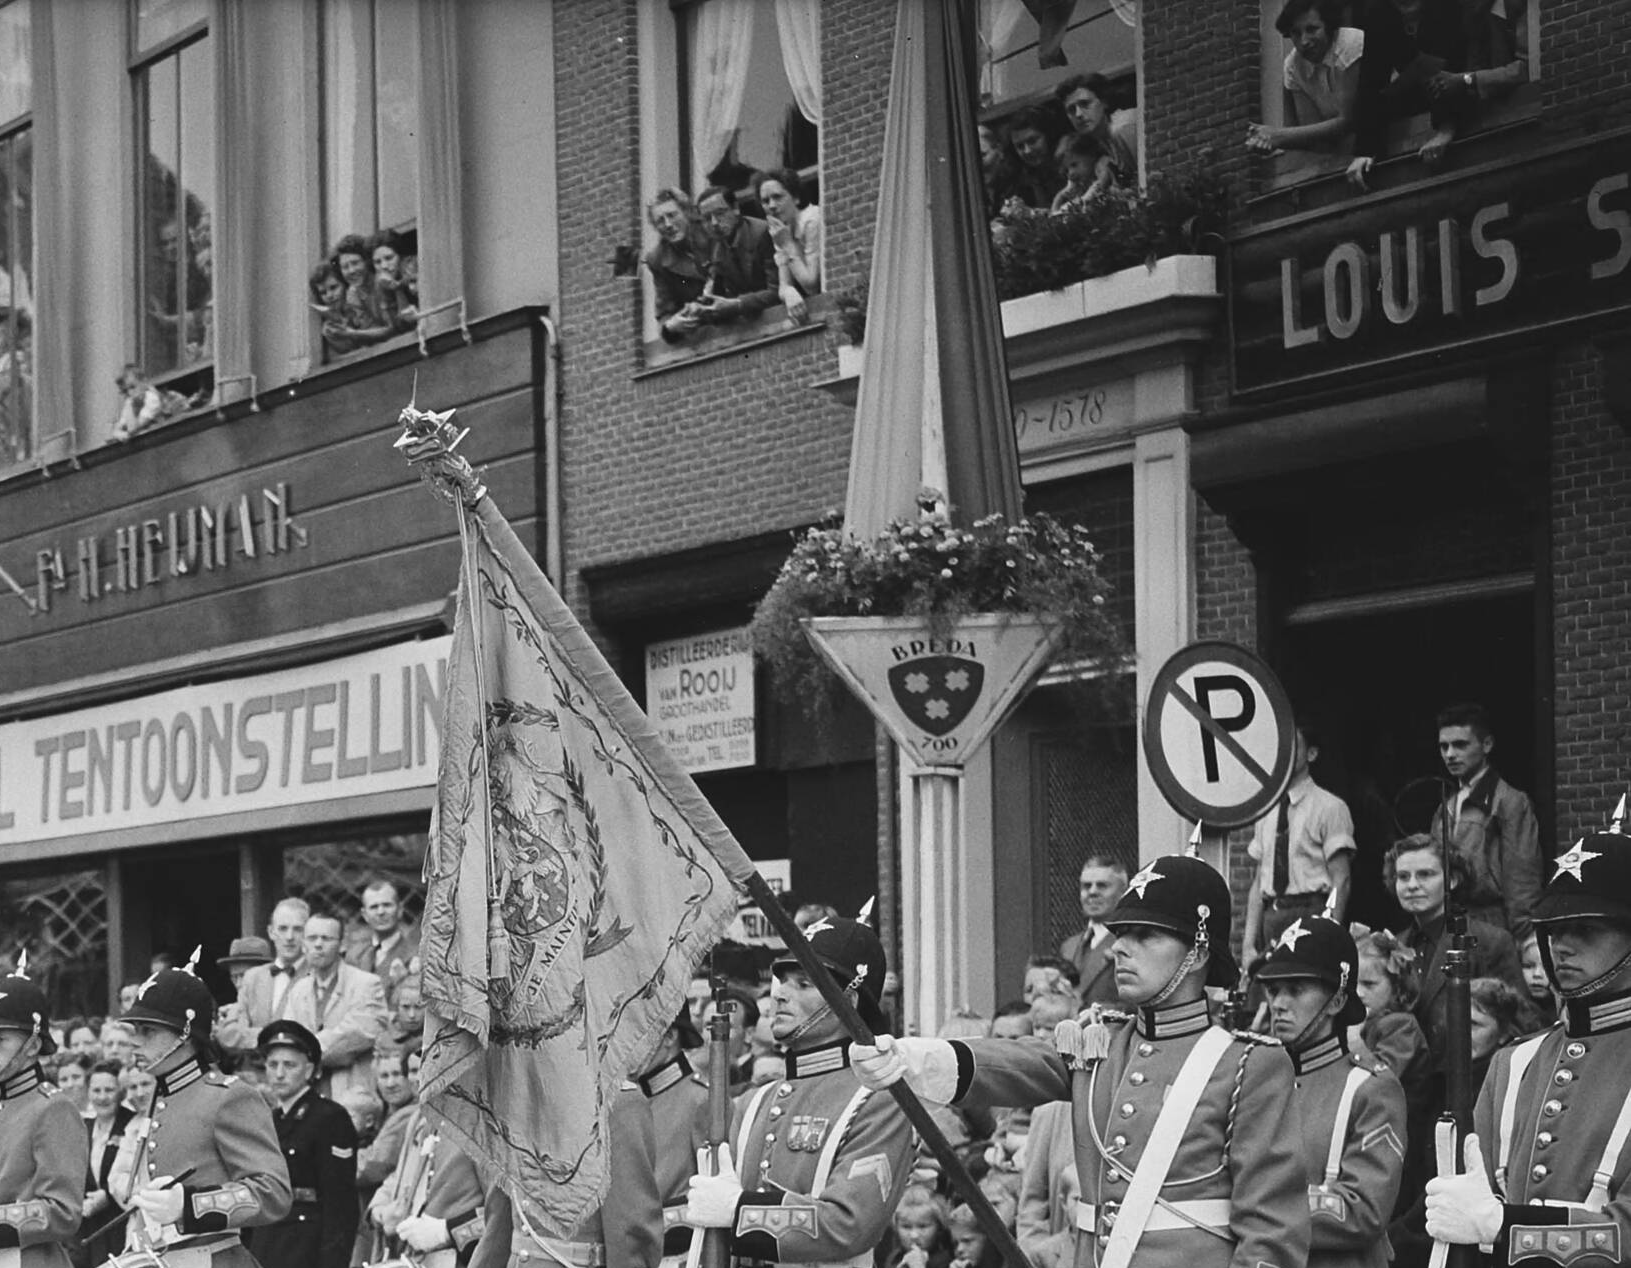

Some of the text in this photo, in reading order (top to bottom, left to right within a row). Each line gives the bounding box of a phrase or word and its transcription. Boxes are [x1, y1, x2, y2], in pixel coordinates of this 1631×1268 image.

[1280, 201, 1519, 349] LOUIS
[891, 640, 977, 661] BREDA
[1194, 675, 1257, 784] P
[921, 736, 958, 752] 700
[528, 973, 543, 996] JE
